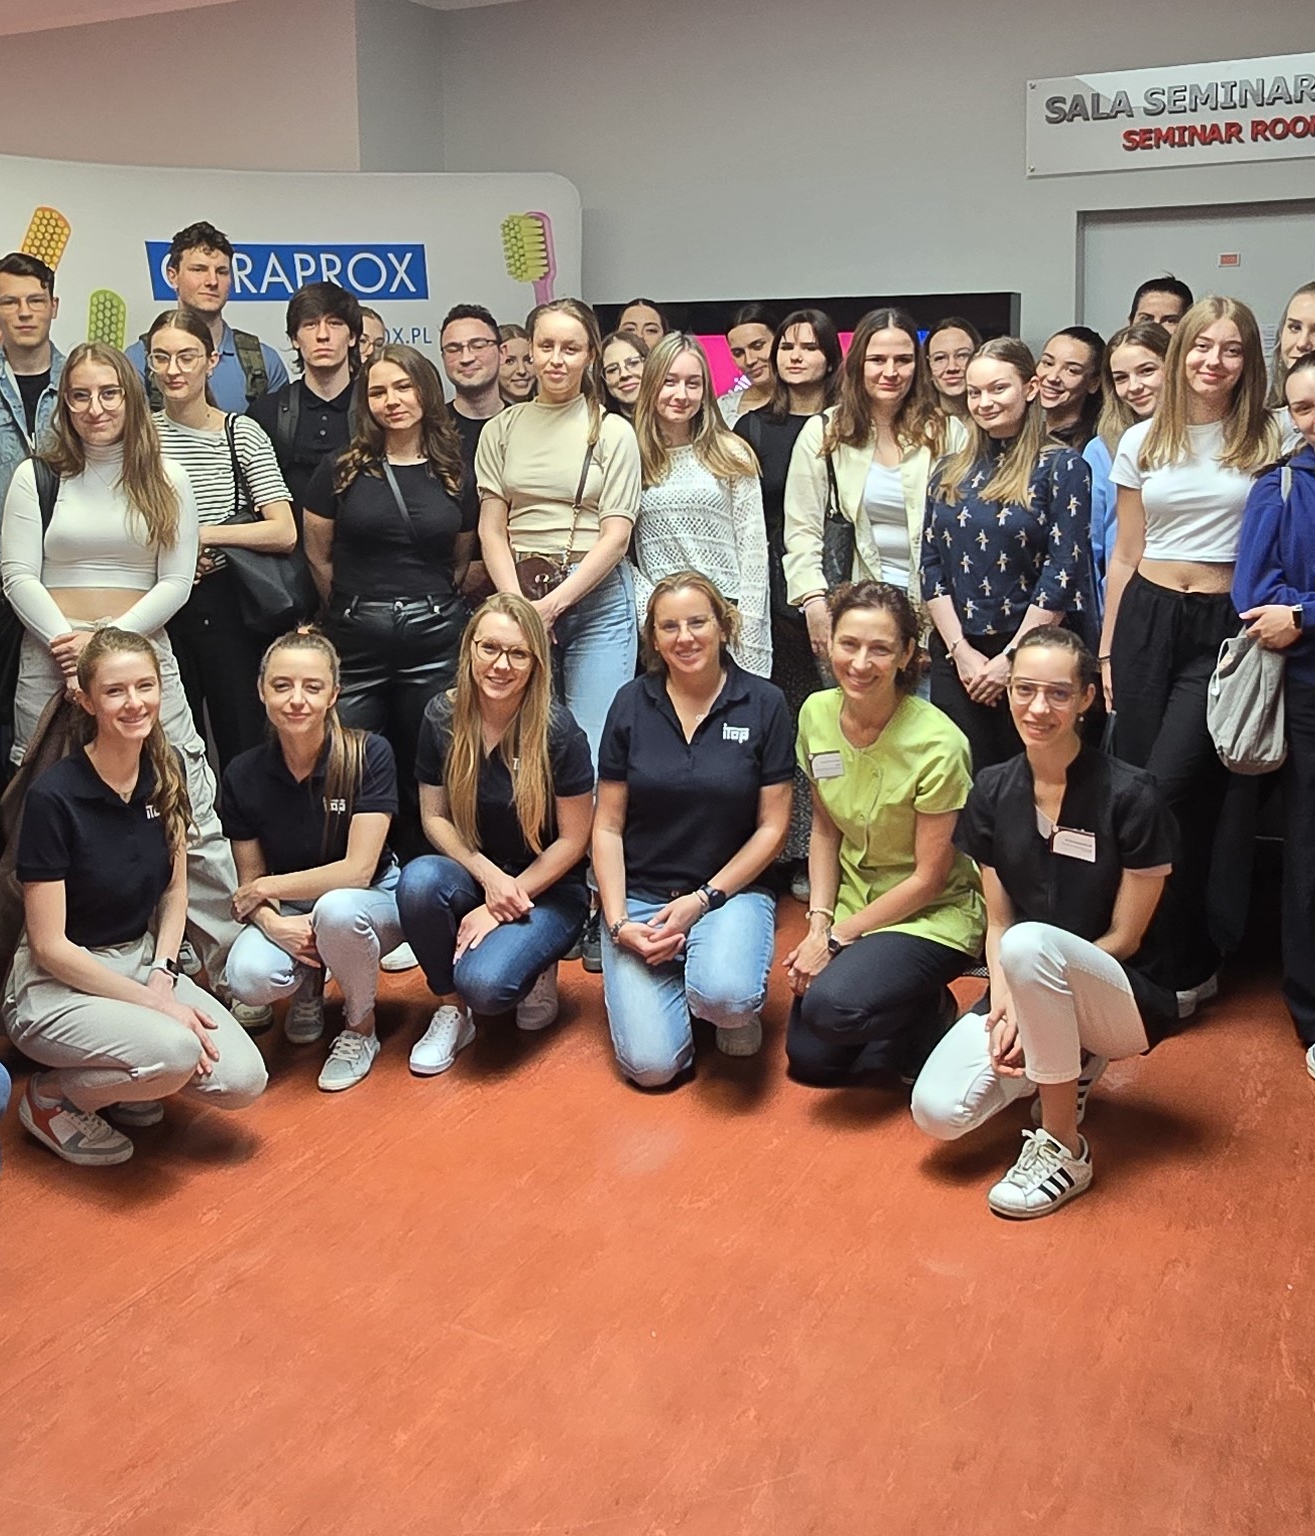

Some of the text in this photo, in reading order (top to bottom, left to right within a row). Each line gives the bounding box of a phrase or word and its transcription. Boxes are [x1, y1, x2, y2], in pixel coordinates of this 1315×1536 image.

[1044, 90, 1134, 124] SALA
[1122, 122, 1245, 152] SEMINAR
[160, 252, 417, 294] RAPROX
